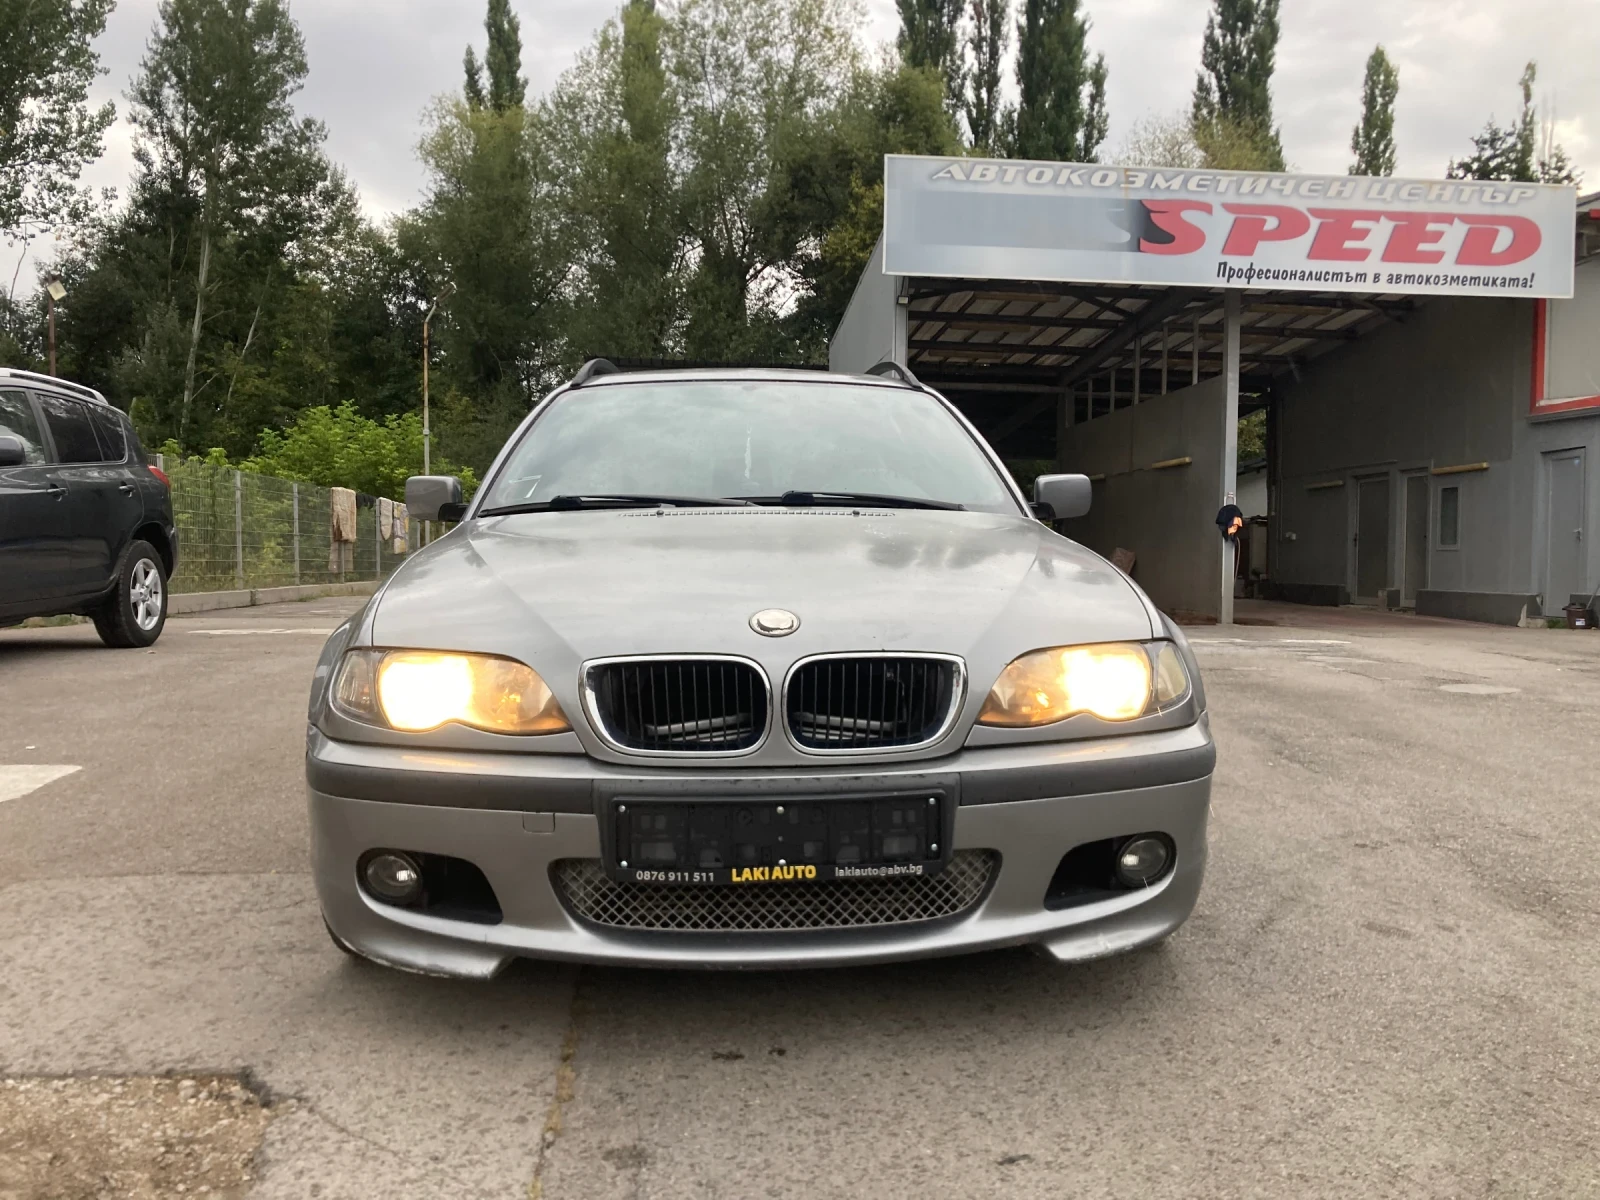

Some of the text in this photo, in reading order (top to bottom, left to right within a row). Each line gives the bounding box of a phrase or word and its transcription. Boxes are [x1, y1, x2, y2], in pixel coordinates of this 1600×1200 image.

[931, 163, 1535, 204] АВТОКОЗМЕТИЧЕН ЦЕНТЪР
[1138, 199, 1541, 266] SPEED
[1216, 262, 1535, 289] Професионалистът в автокозметиката!
[636, 869, 714, 883] 0876 911 511
[731, 865, 817, 883] LAKI AUTO
[835, 863, 923, 878] lakiauto@abv.bg
